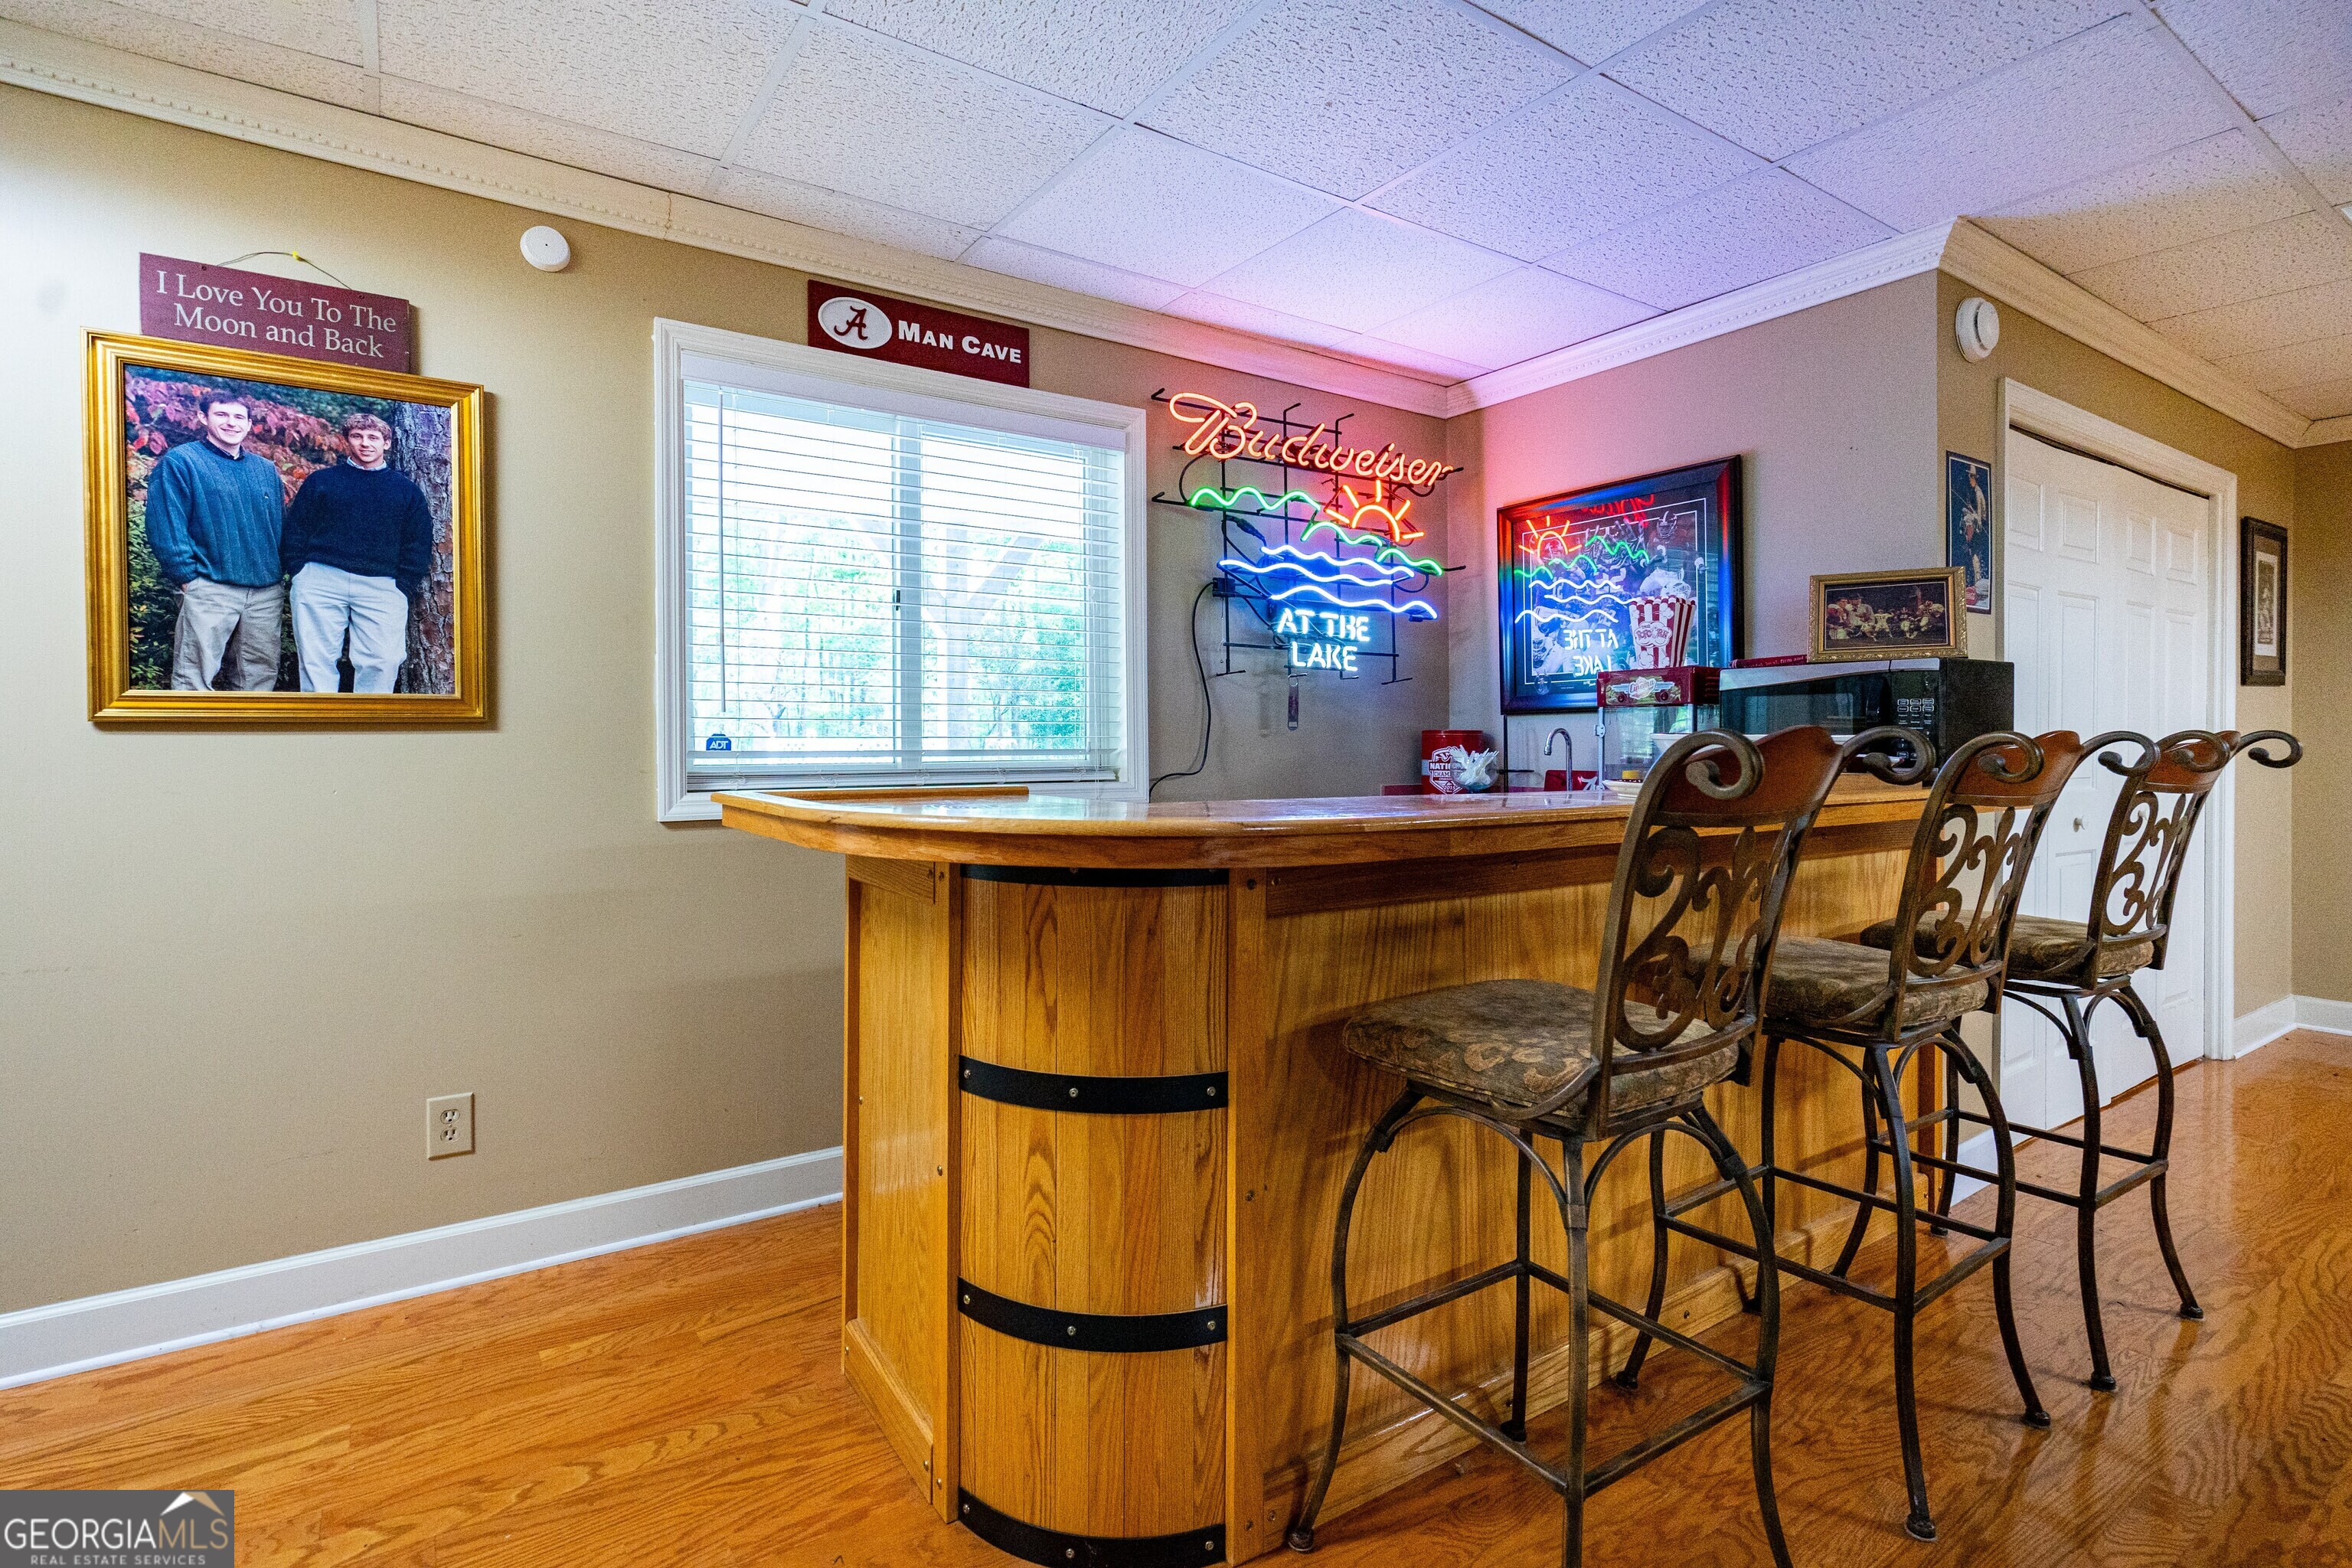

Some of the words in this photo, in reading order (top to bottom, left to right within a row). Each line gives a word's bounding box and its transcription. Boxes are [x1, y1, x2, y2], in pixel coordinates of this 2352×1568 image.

[156, 270, 167, 295] I
[175, 274, 243, 306] Love
[251, 287, 304, 318] You
[311, 298, 342, 324] To
[349, 305, 397, 333] The
[174, 303, 257, 339] Moon
[266, 325, 315, 348] and
[324, 328, 384, 358] Back
[834, 305, 868, 341] A
[898, 320, 953, 350] MAN
[962, 336, 1021, 364] CAVE
[1169, 393, 1454, 486] Budweiser
[1277, 609, 1315, 635] AT
[1320, 612, 1370, 642] THE
[1292, 641, 1358, 671] LAKE
[709, 740, 729, 750] ADT
